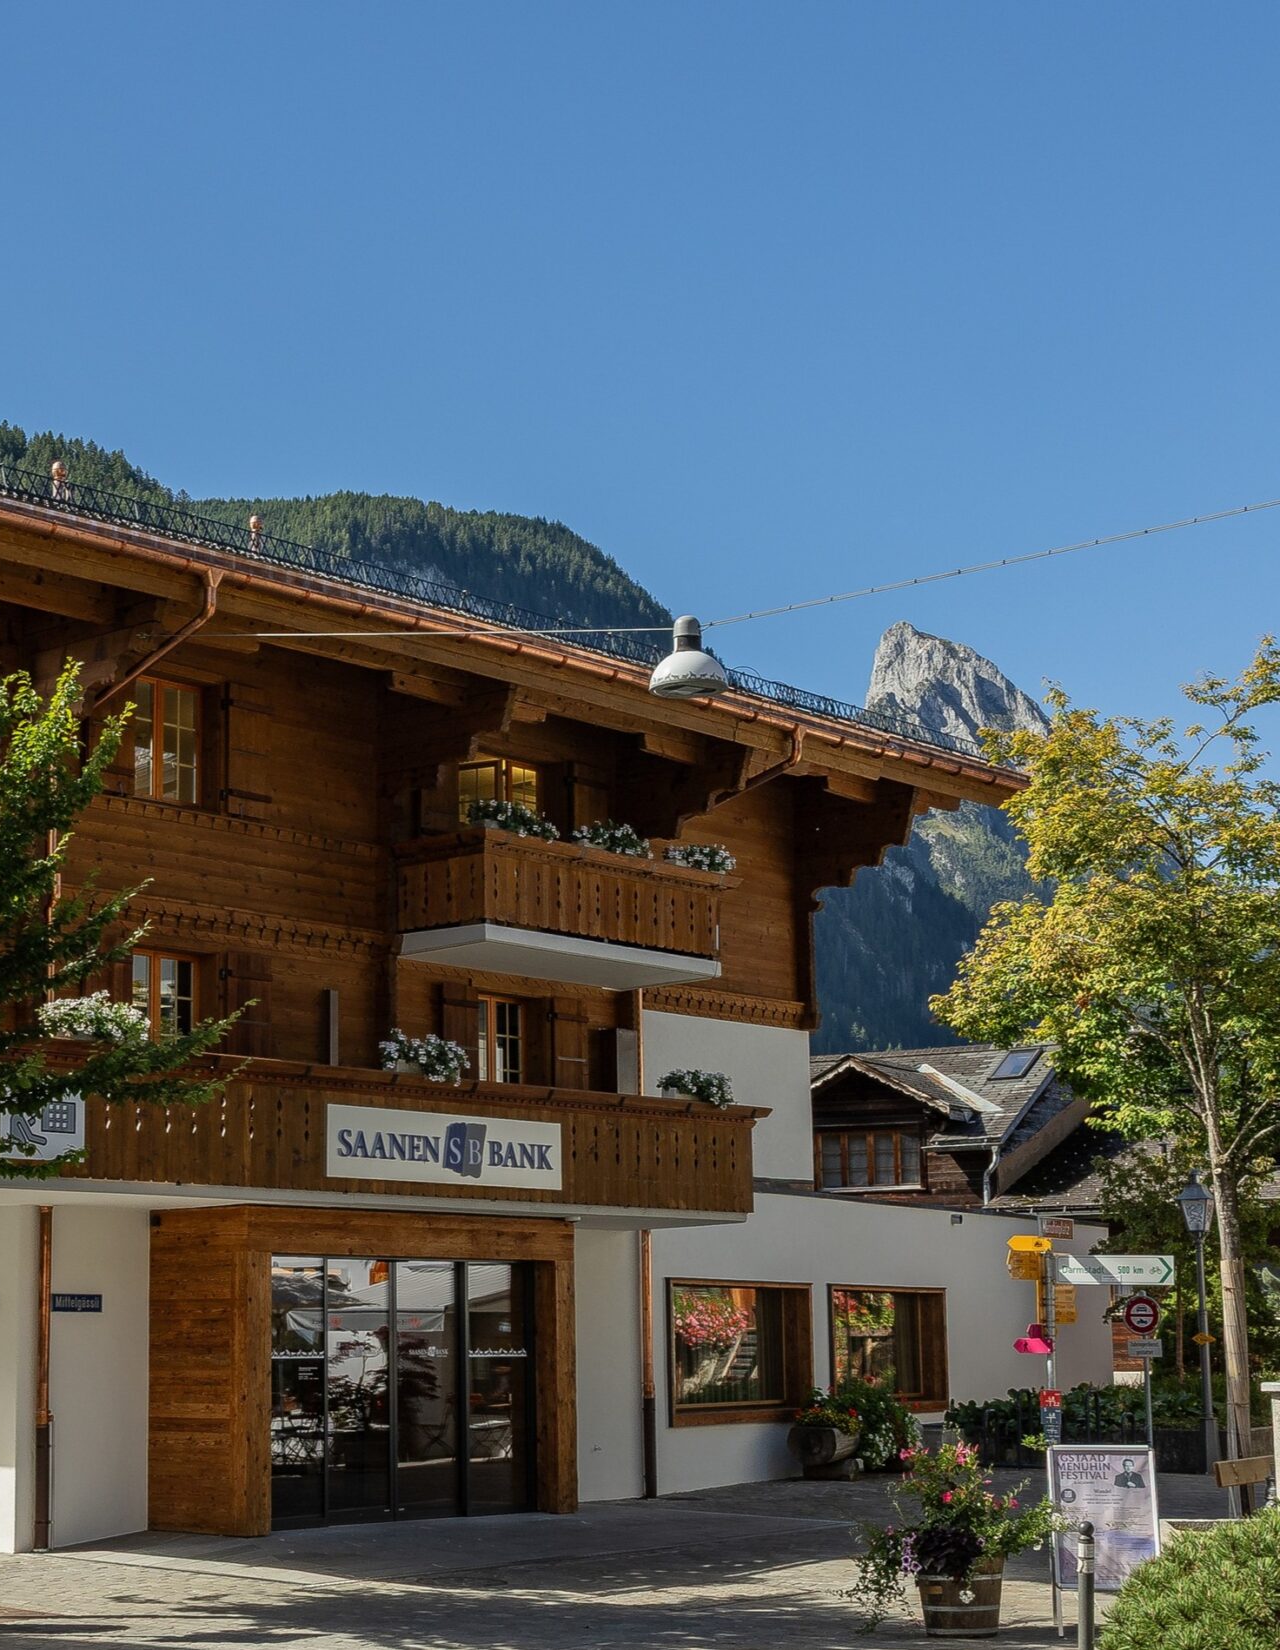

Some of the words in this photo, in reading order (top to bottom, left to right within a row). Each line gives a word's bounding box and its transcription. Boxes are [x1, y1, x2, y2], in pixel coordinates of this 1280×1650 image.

[337, 1129, 440, 1163] SAANEN
[488, 1140, 553, 1170] BANK
[1061, 1264, 1105, 1275] Darmstadt
[1117, 1265, 1130, 1274] 500
[1133, 1265, 1144, 1274] km
[1060, 1454, 1106, 1463] GSTAAD
[1057, 1462, 1111, 1471] MENUHIN
[1060, 1471, 1109, 1480] FESTIVAL
